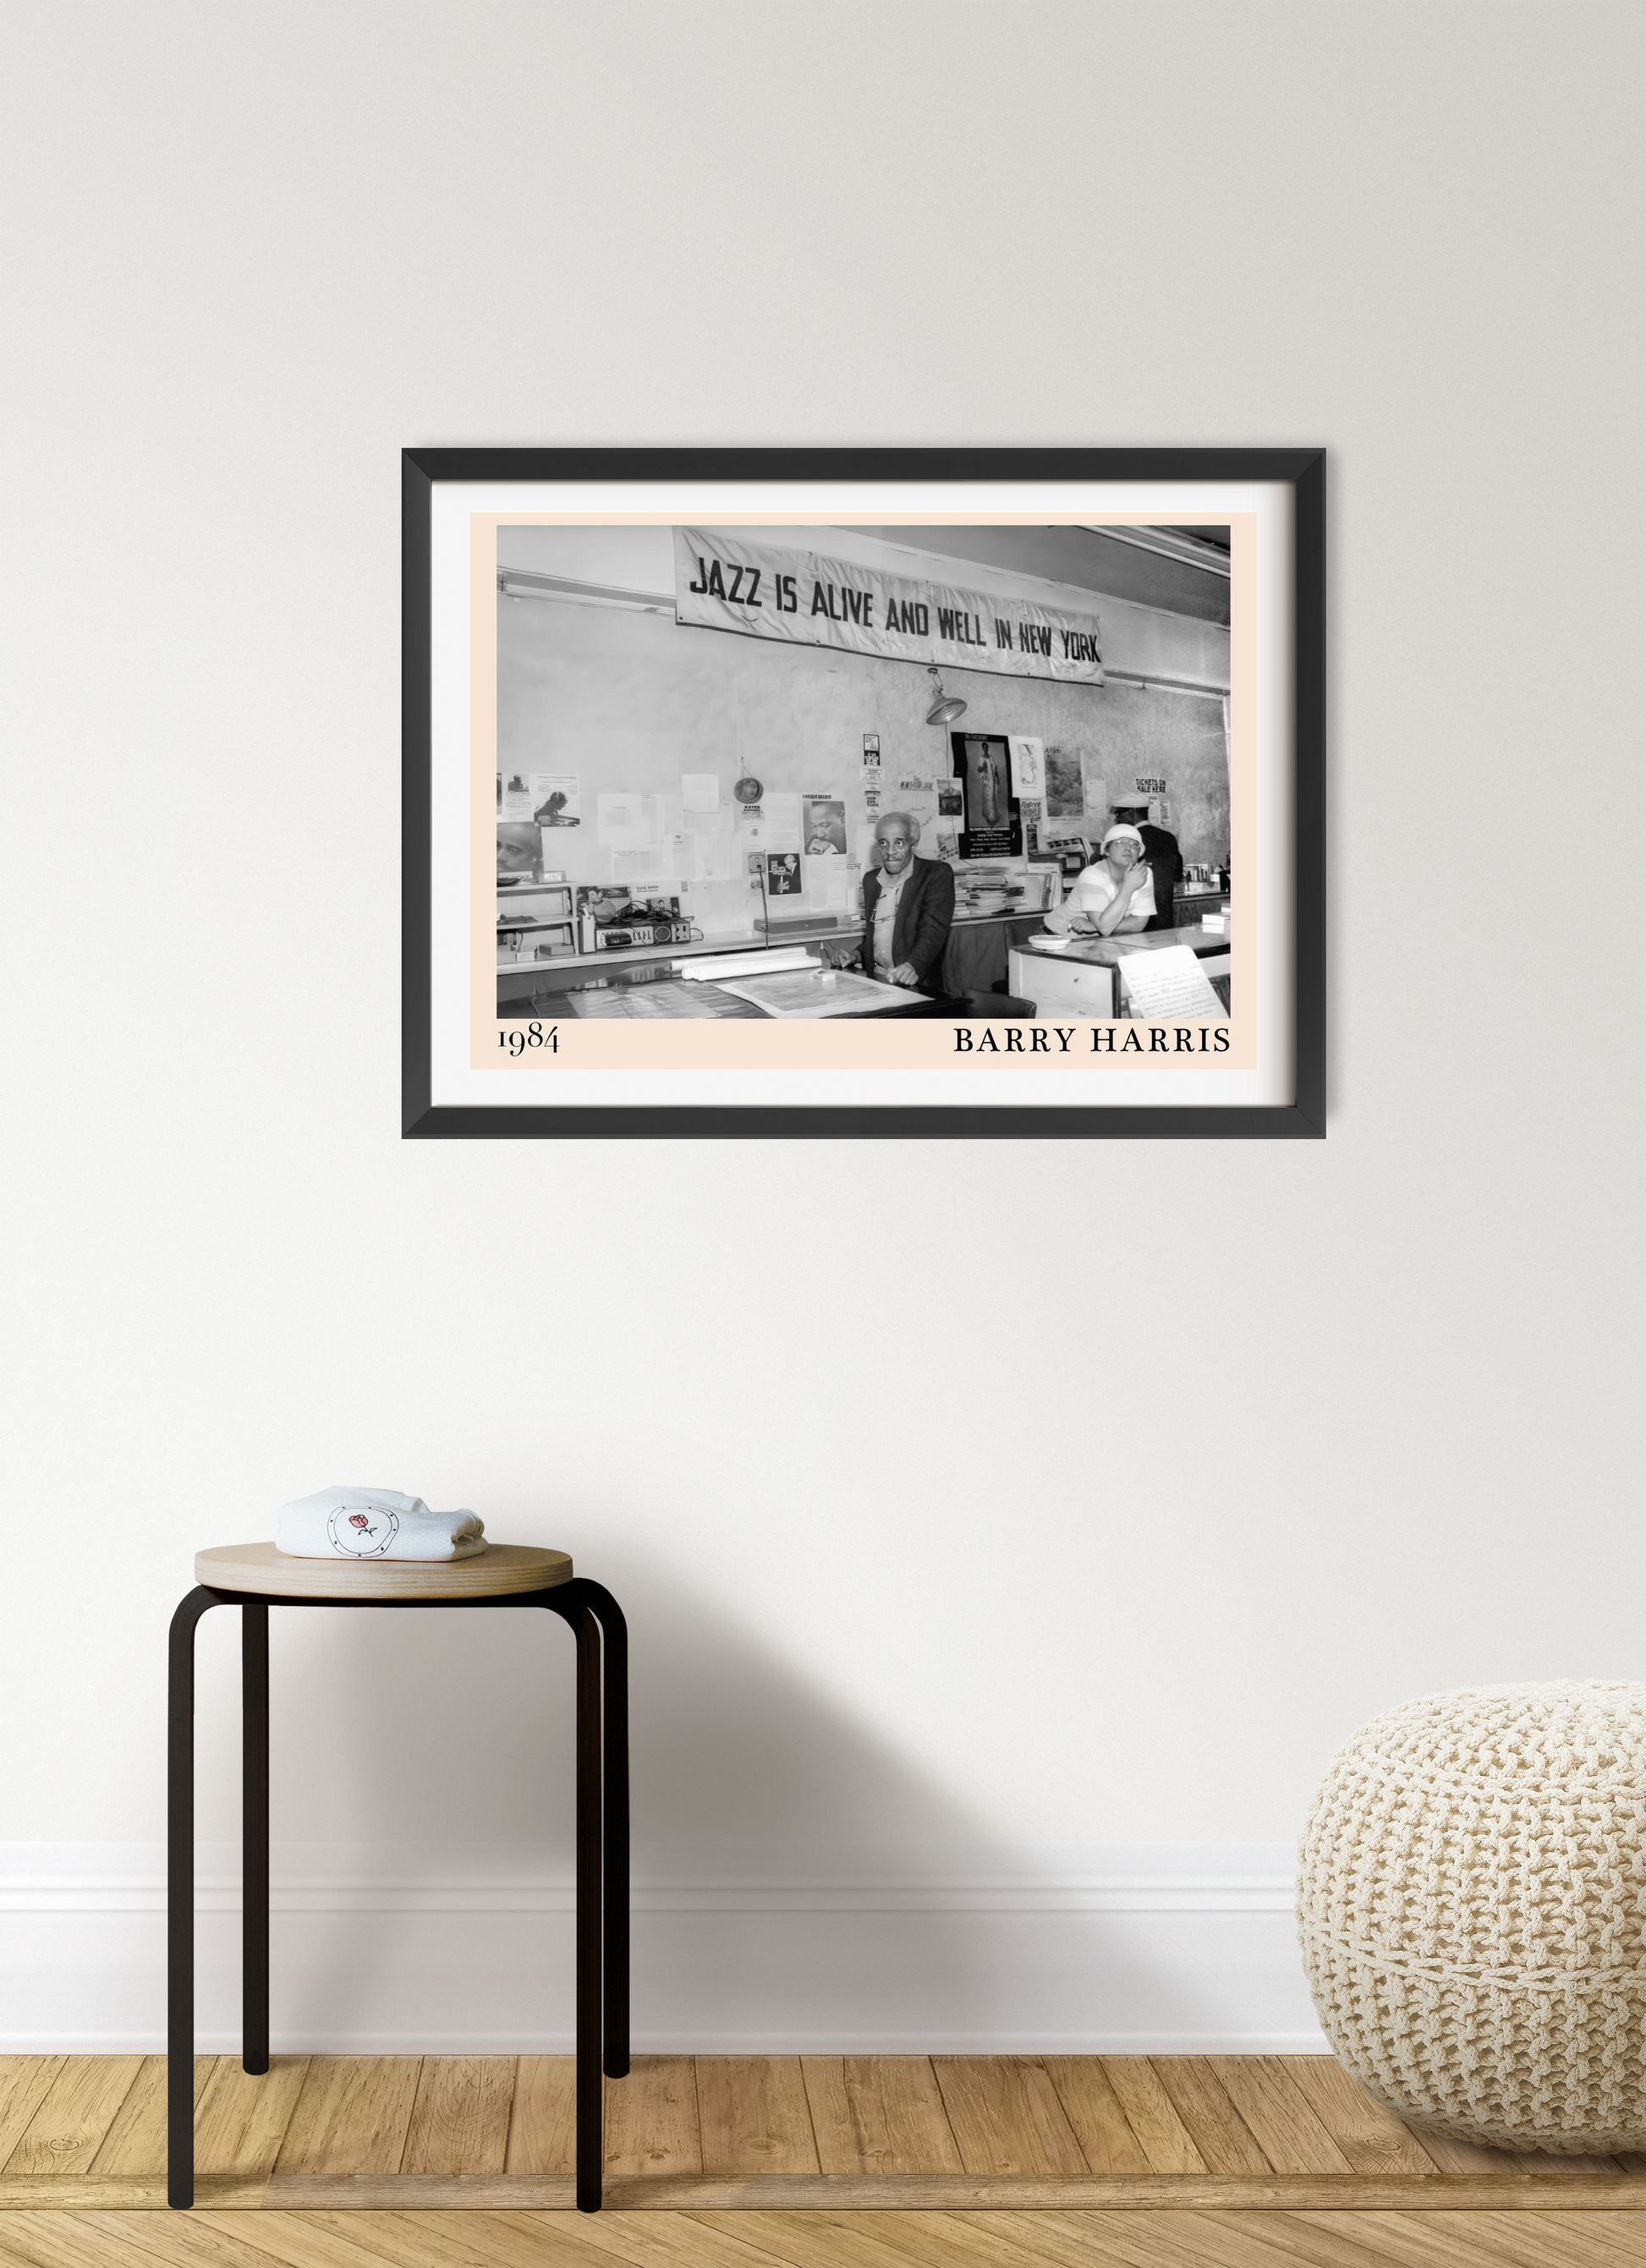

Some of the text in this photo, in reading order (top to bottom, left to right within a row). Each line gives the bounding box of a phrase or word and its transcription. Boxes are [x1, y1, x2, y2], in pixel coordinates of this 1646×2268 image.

[689, 556, 1103, 664] JAZZ IS ALIVE AND WELL IN NEW YORK
[1136, 778, 1158, 786] TICKETS
[497, 1022, 560, 1057] 1984
[953, 1027, 1230, 1053] BARRY HARRIS
